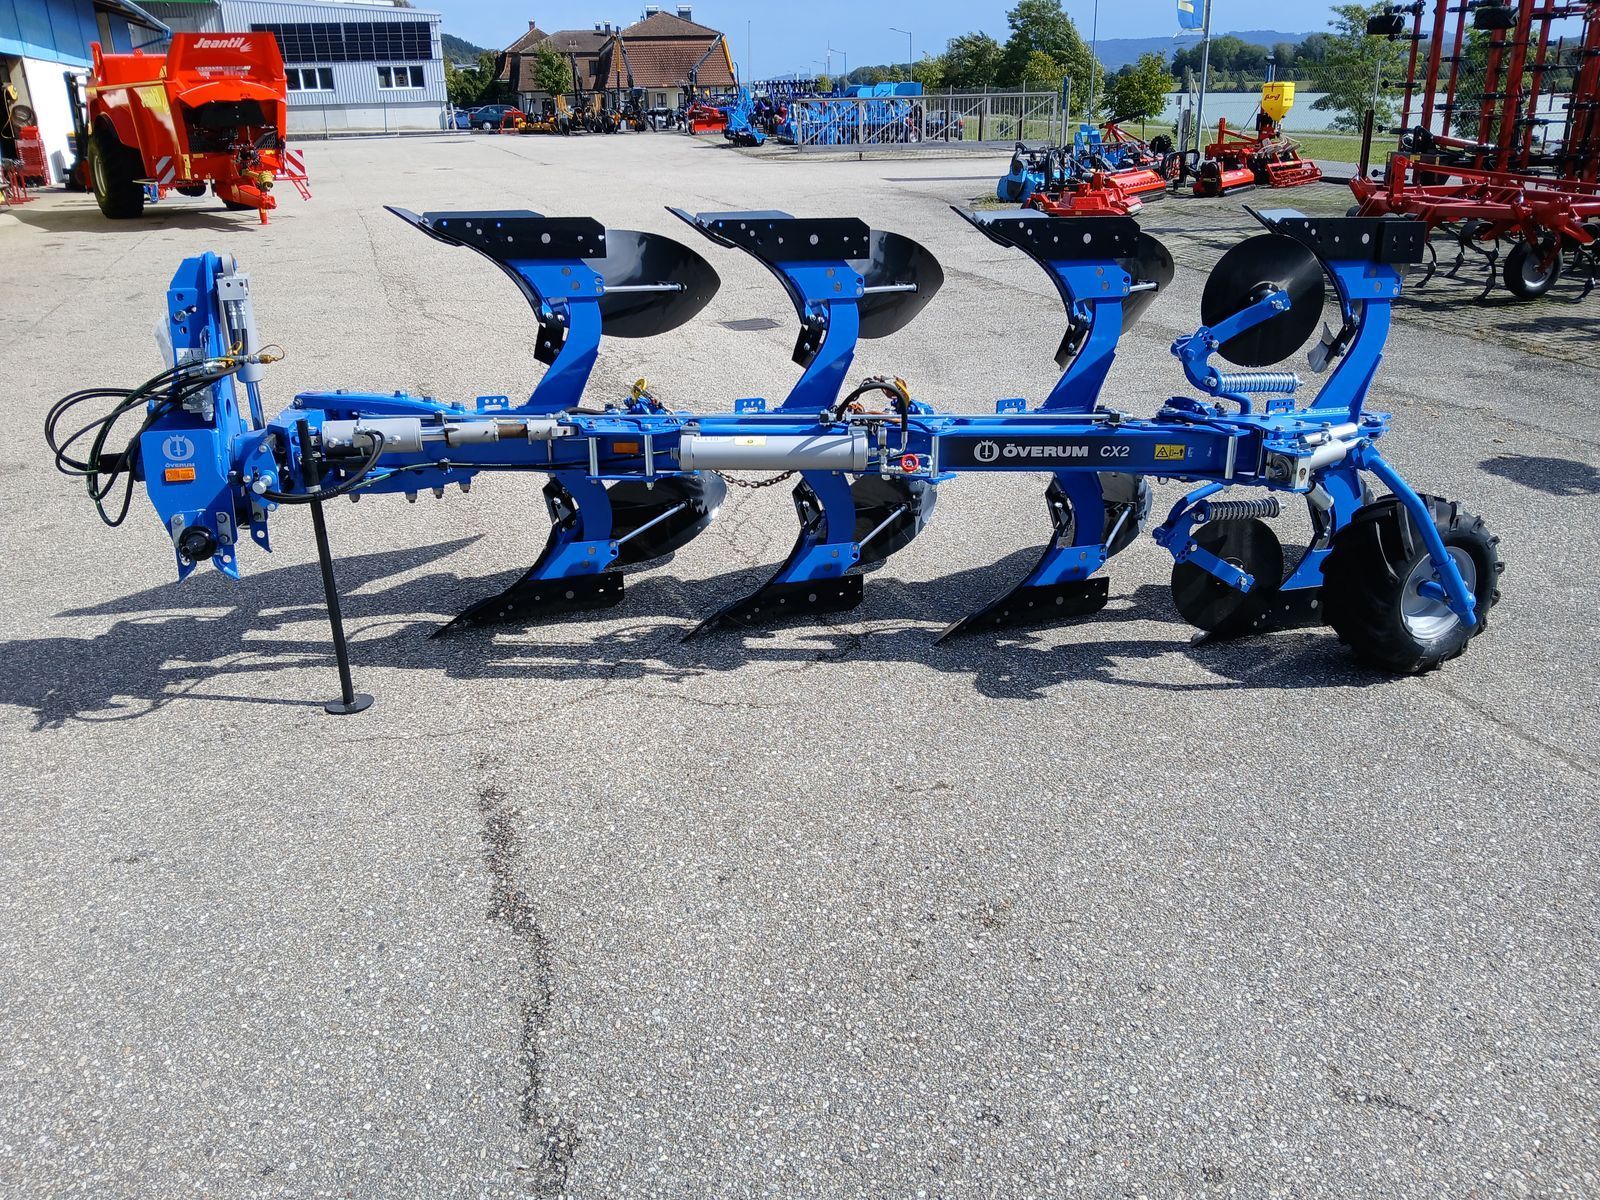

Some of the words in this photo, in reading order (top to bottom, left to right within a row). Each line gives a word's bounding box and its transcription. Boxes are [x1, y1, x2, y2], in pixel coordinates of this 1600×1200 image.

[193, 37, 246, 49] Jeantil
[1002, 443, 1089, 458] ÖVERUM
[1100, 445, 1130, 457] CX2
